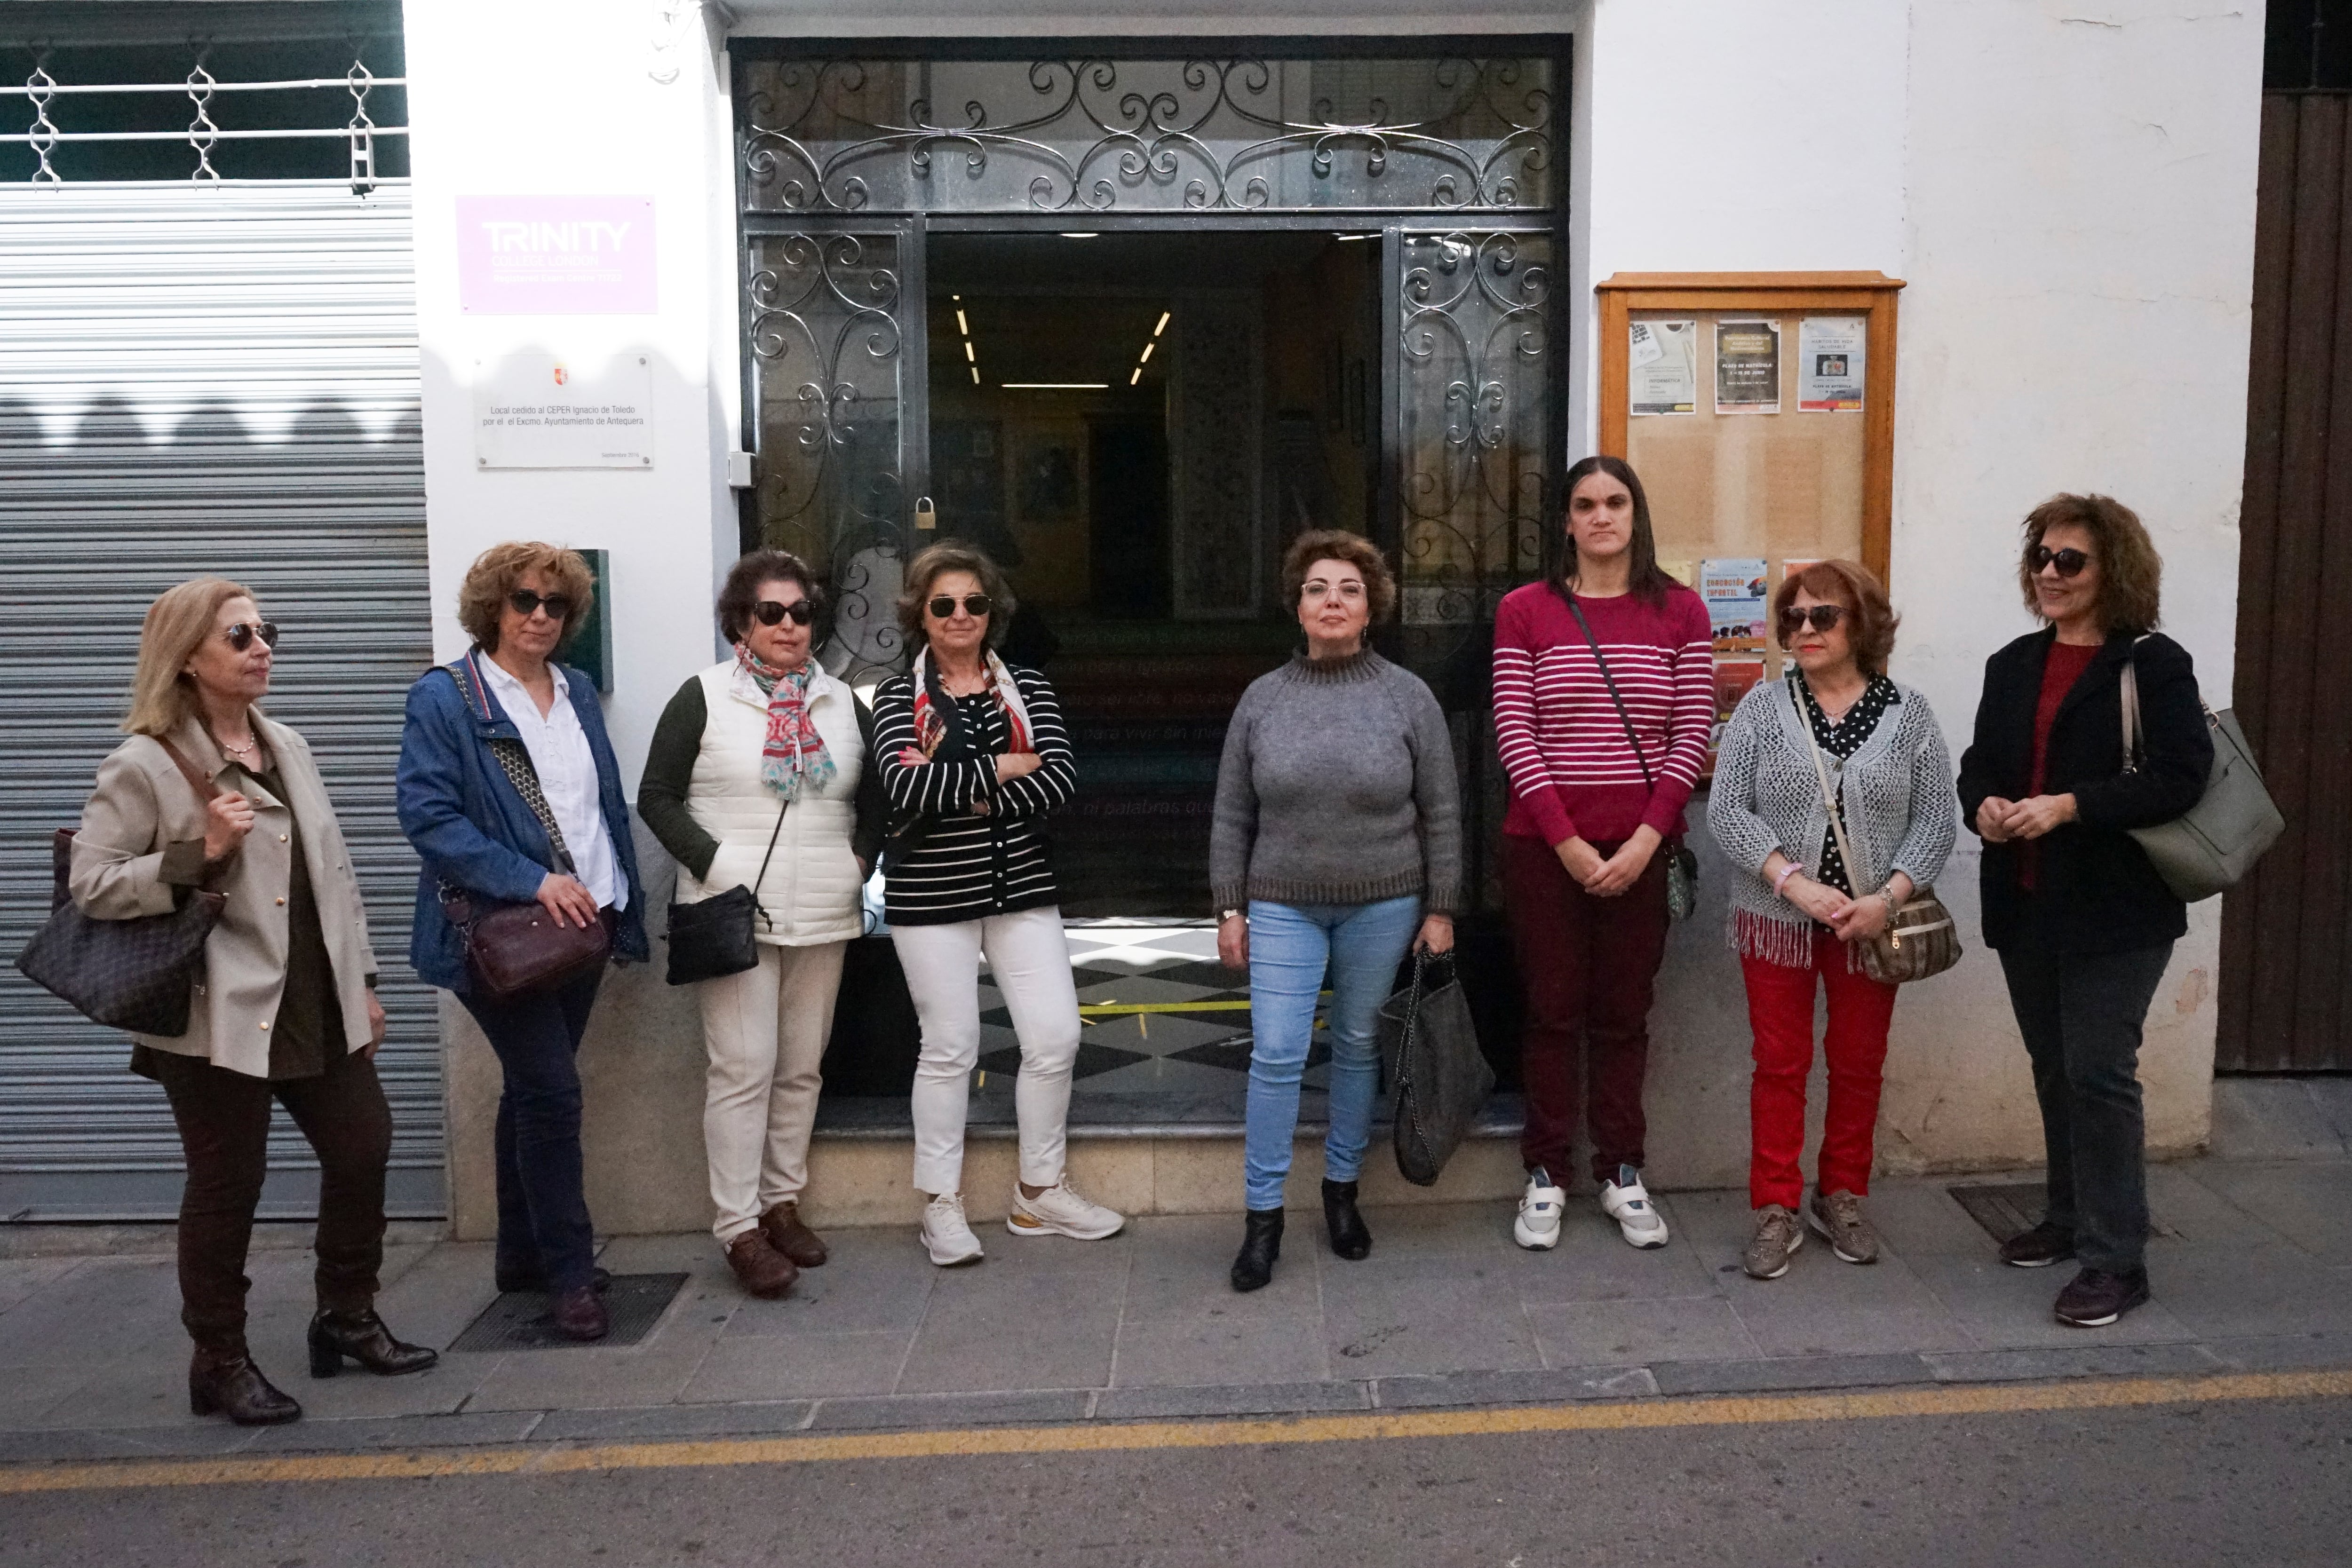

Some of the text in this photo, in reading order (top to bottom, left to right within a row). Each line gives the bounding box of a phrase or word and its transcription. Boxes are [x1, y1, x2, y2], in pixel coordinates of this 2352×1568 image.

[481, 221, 632, 252] TRINITY
[491, 255, 599, 267] COLLEGE LONDON
[493, 274, 539, 284] Registered
[566, 274, 595, 282] Centre
[573, 406, 599, 415] Ignacio
[612, 405, 635, 414] Toledo
[544, 417, 594, 427] Ayuntamiento
[607, 417, 644, 426] Antequera
